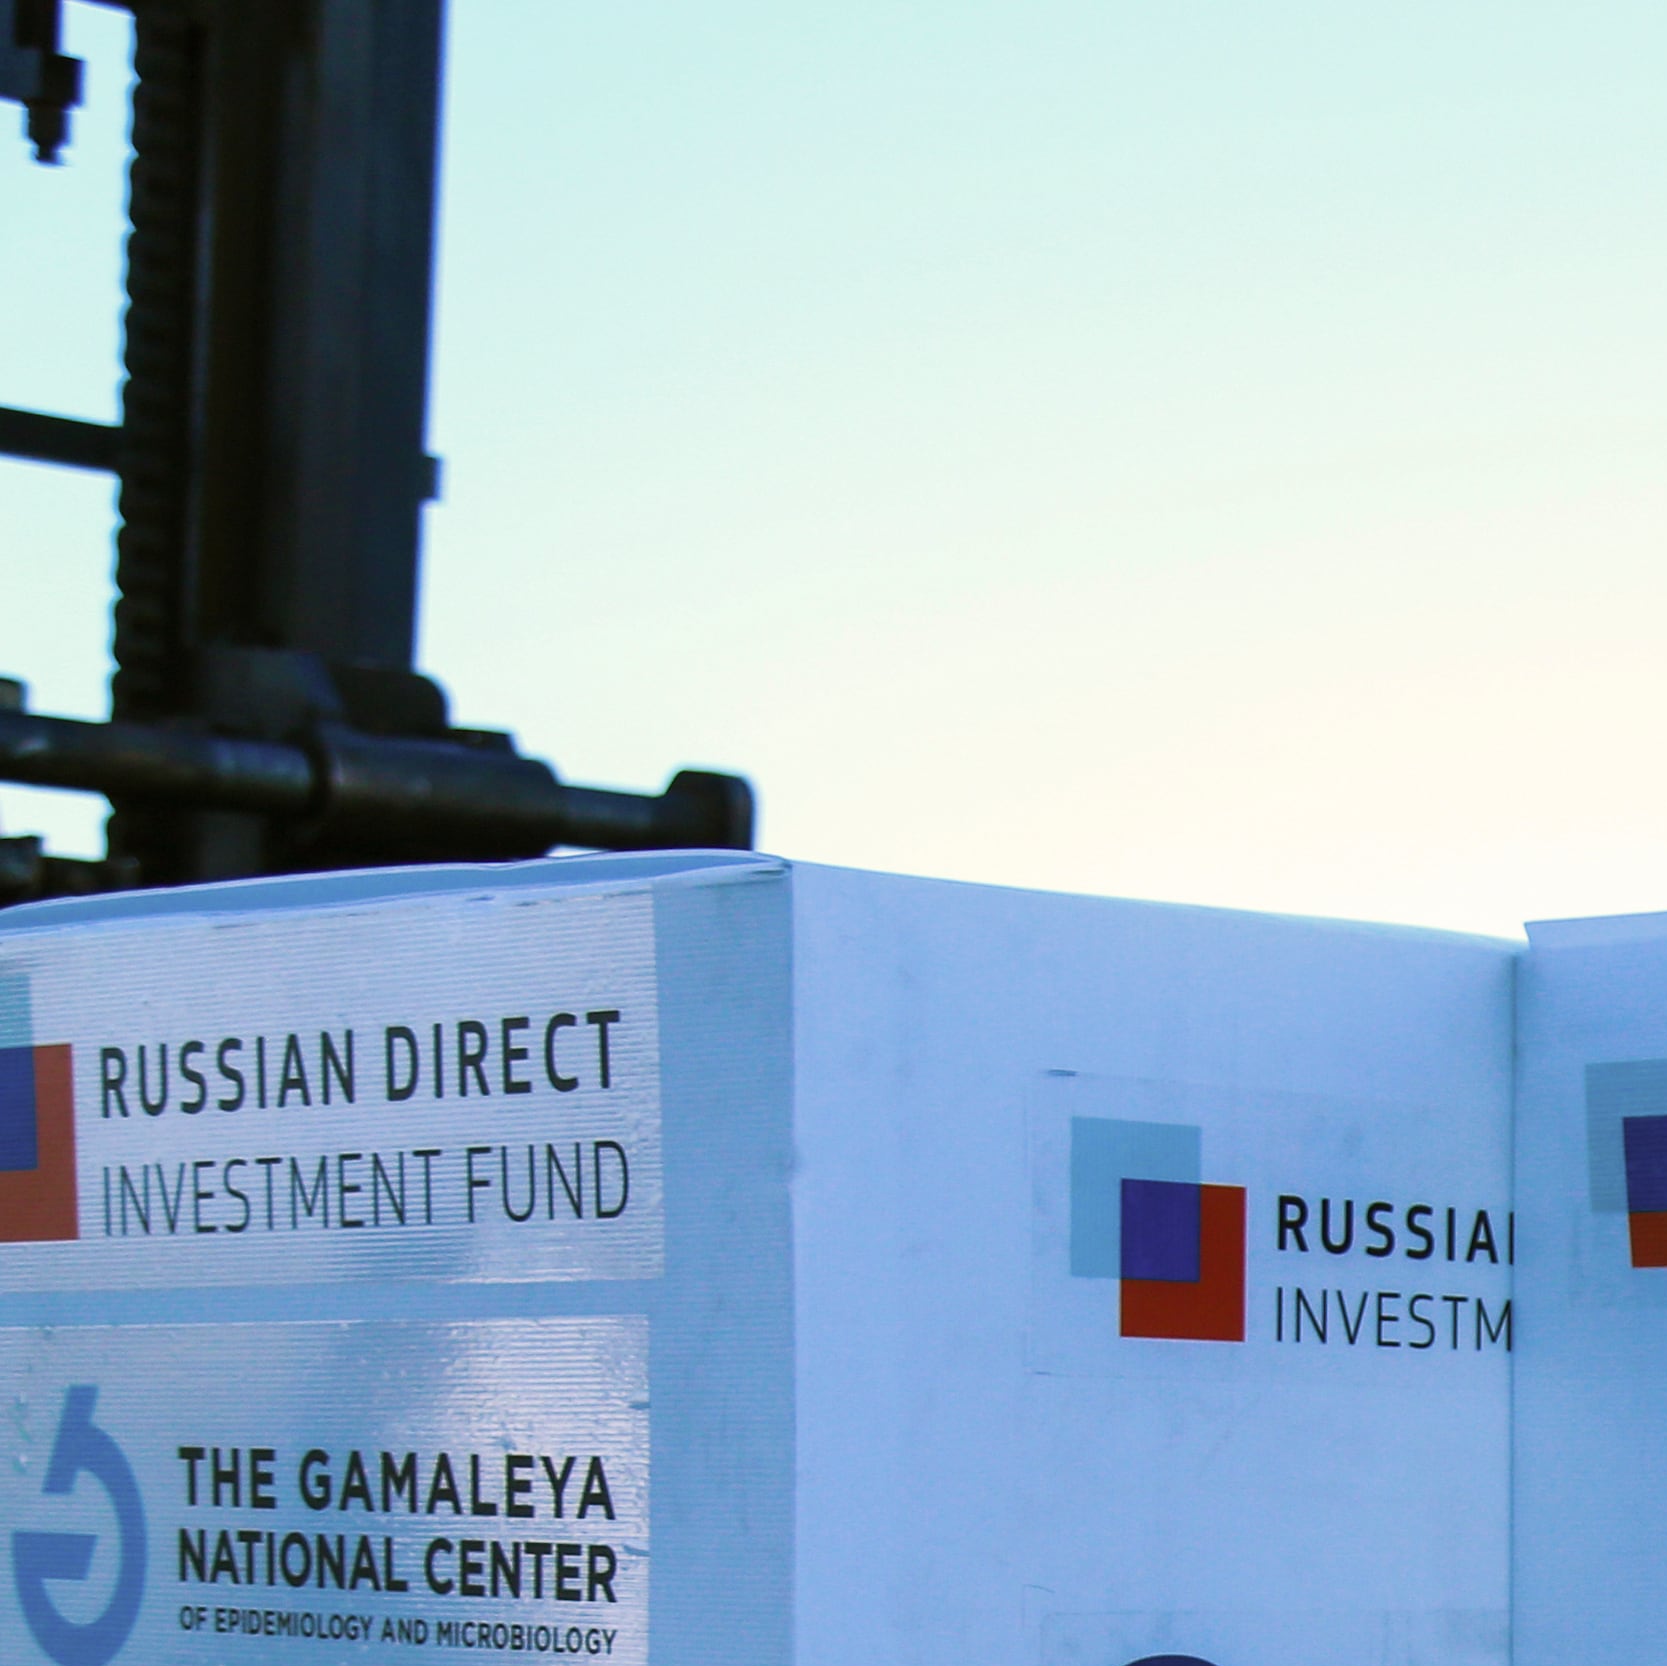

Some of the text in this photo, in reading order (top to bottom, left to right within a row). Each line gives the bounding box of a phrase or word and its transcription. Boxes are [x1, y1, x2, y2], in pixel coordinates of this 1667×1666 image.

[102, 1010, 622, 1119] RUSSIAN DIRECT
[103, 1140, 629, 1235] INVESTMENT FUND
[1277, 1194, 1515, 1266] RUSSIA
[178, 1446, 616, 1520] THE GAMALEYA
[179, 1528, 618, 1602] NATIONAL CENTER
[180, 1606, 617, 1654] OF EPIDEMIOLOGY AND MICROBIOLOGY
